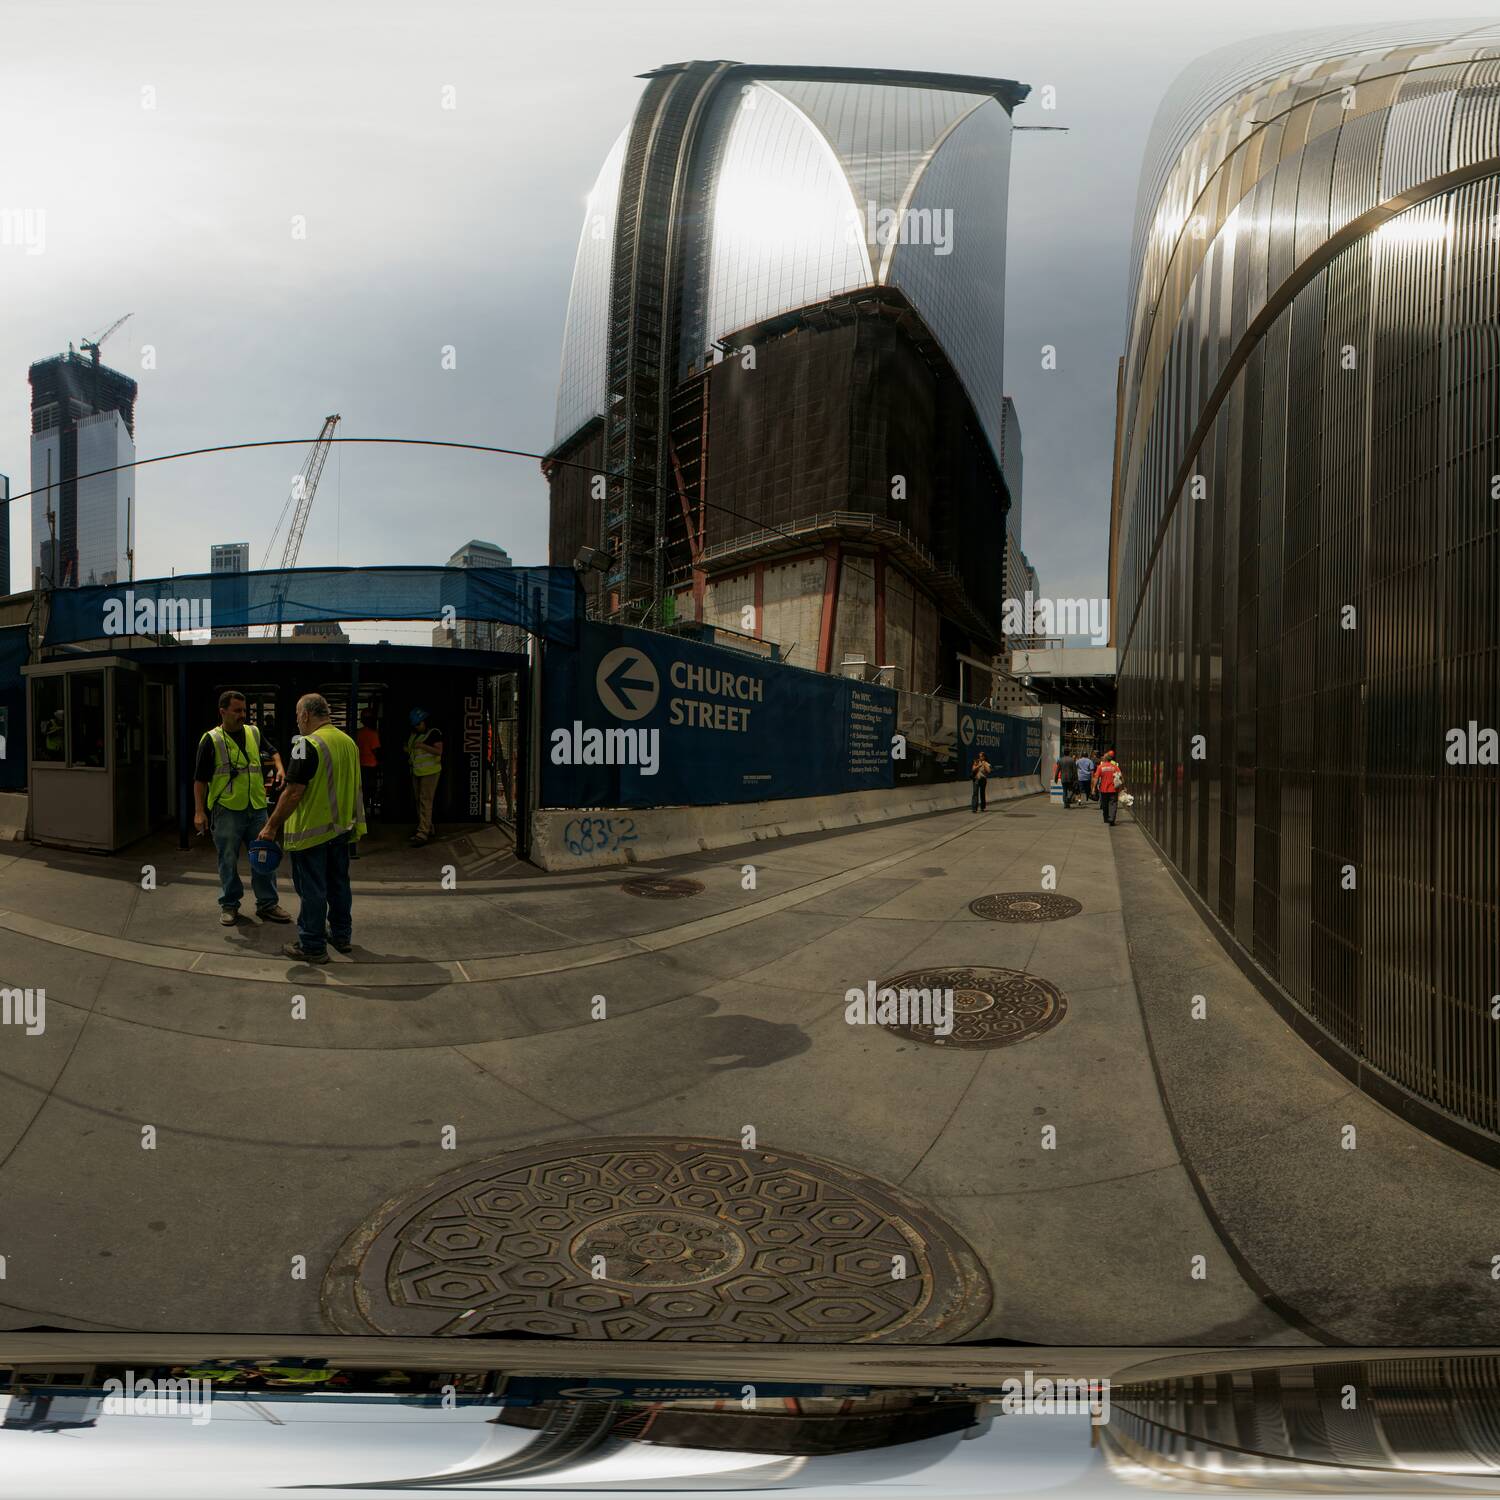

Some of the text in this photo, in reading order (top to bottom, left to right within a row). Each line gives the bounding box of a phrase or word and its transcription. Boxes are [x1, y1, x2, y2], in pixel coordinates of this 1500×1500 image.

[670, 660, 763, 702] CHURCH
[669, 697, 752, 732] STREET
[976, 718, 1005, 734] WTC PATH
[975, 734, 1001, 747] STATION
[470, 753, 480, 769] BY
[469, 770, 479, 816] SECURED
